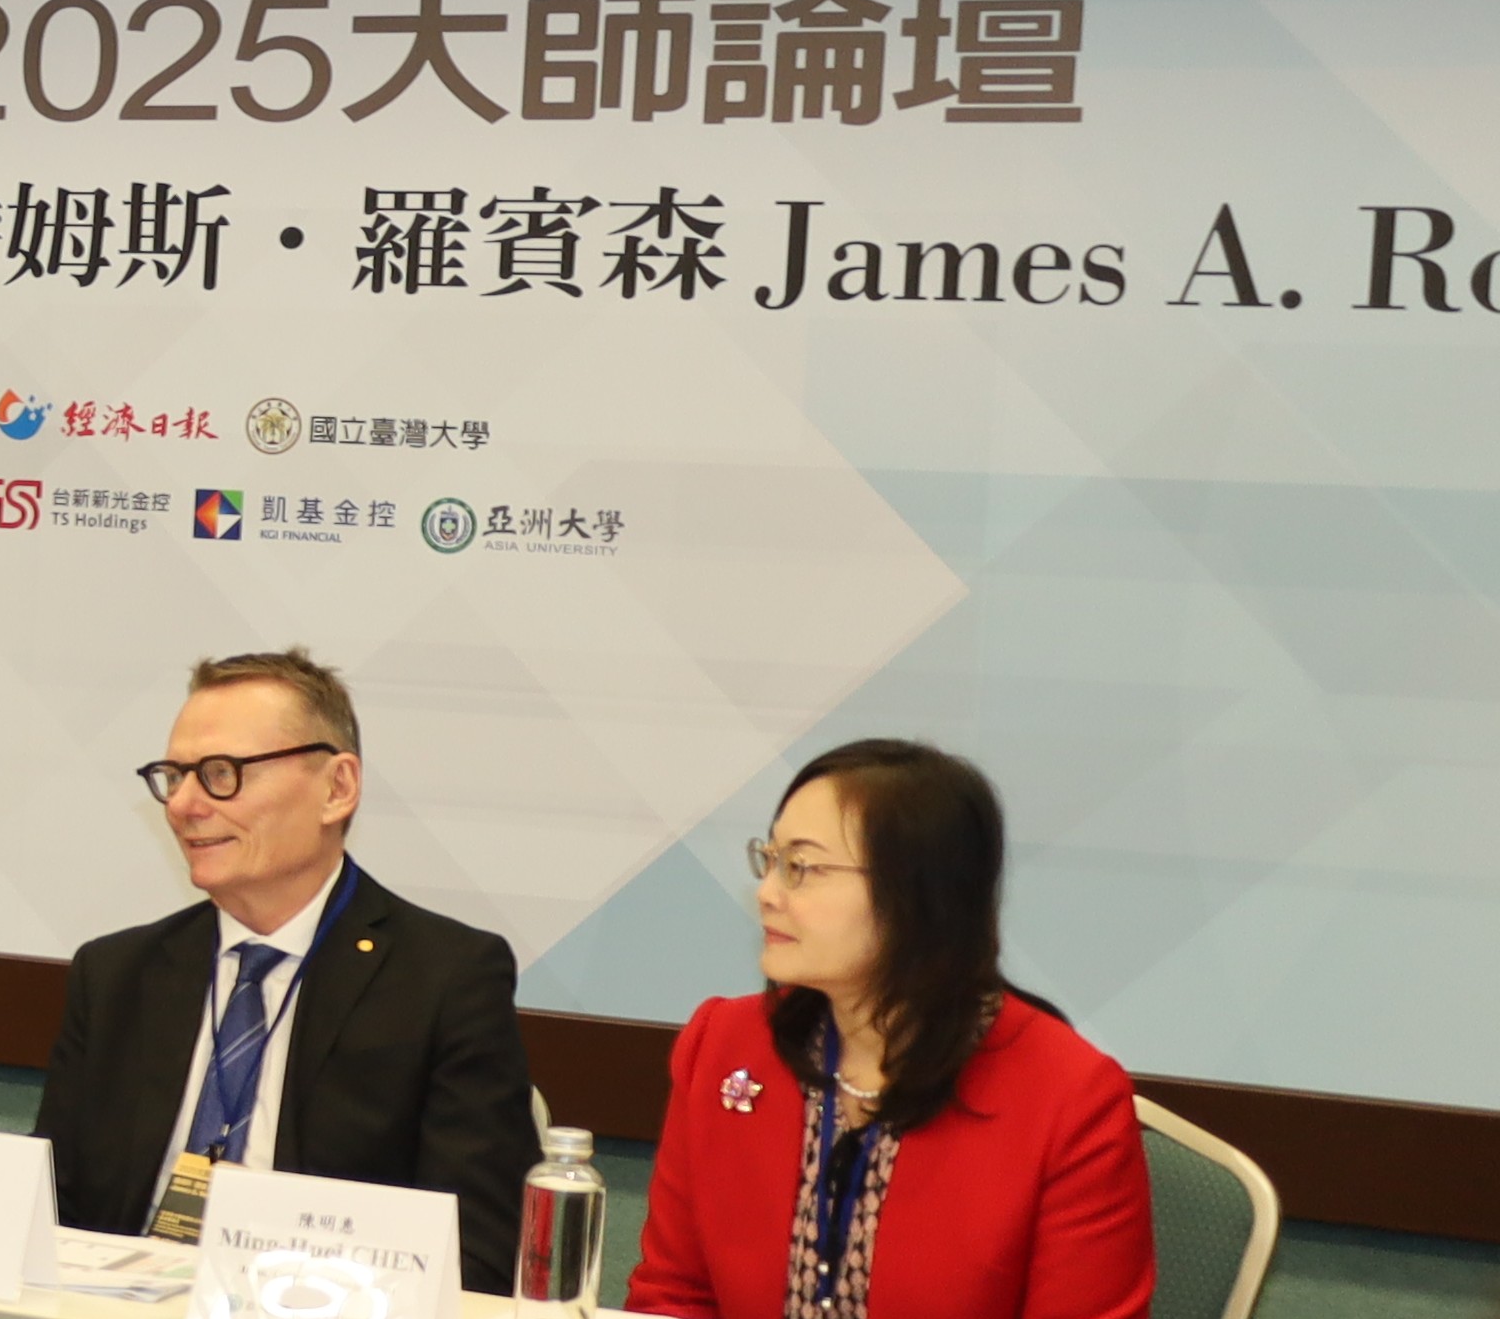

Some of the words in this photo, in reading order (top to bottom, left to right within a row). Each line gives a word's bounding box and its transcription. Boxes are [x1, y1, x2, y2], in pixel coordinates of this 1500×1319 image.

[754, 201, 1127, 311] James
[1165, 202, 1304, 310] A.
[60, 400, 220, 443] 經濟日報
[308, 415, 491, 451] 國立臺灣大學
[51, 512, 70, 527] TS
[75, 513, 148, 534] Holdings
[52, 487, 172, 513] 台新新光金控
[260, 494, 397, 528] 凱基金控
[482, 505, 625, 543] 亞洲大學
[260, 529, 279, 541] KGI
[282, 530, 343, 544] FINANCIAL
[483, 540, 519, 553] ASIA
[526, 542, 619, 558] UNIVERSITY
[350, 1243, 431, 1275] CHEN
